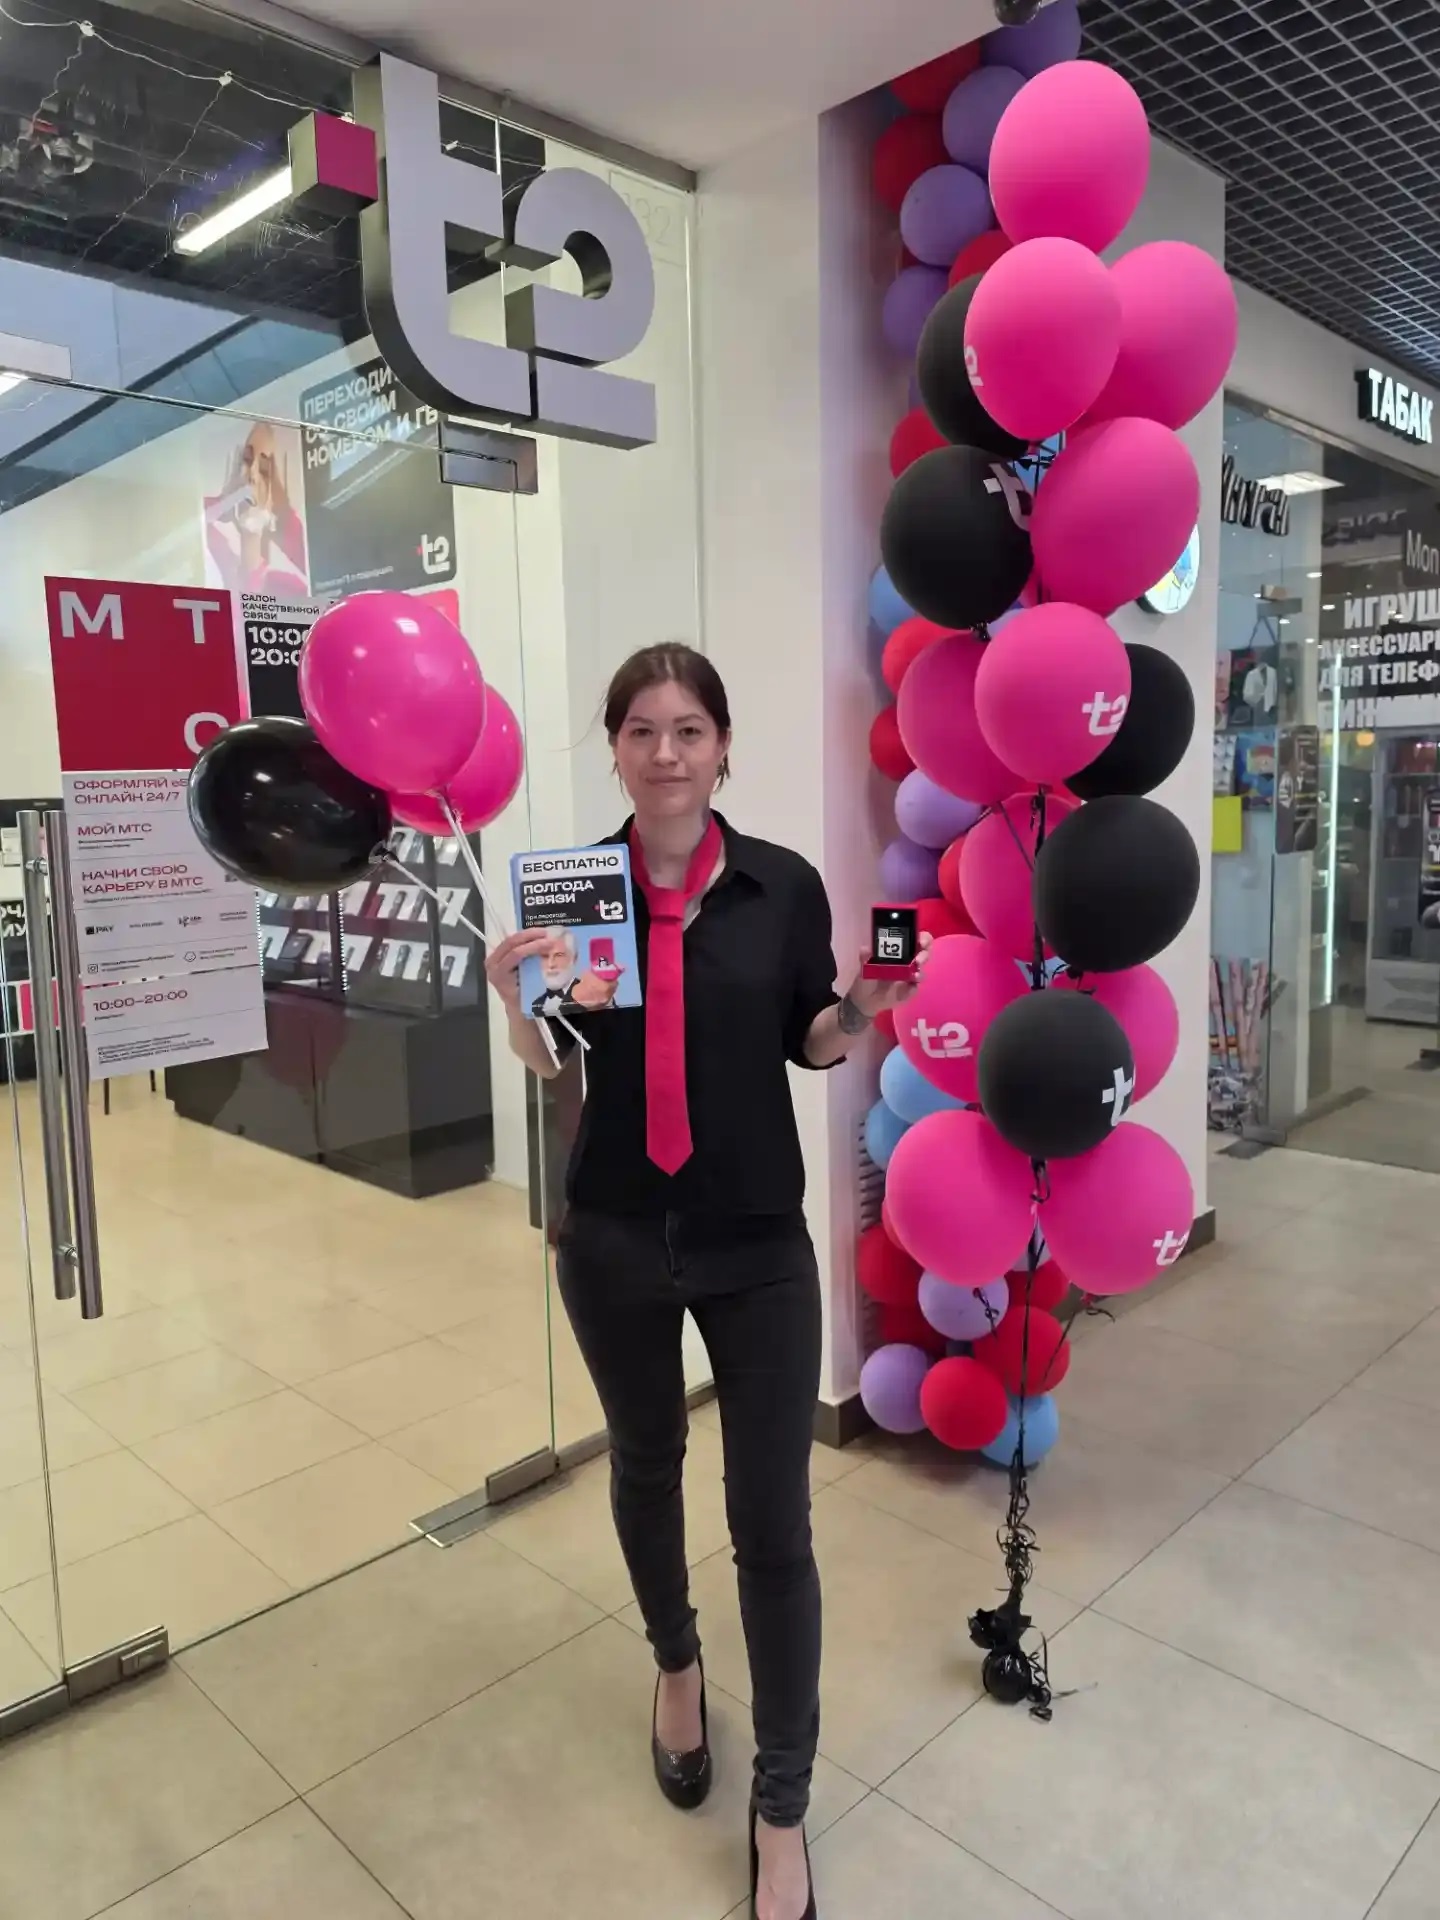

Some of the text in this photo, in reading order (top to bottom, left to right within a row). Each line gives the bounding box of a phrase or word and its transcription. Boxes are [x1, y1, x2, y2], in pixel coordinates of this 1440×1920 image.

[290, 52, 657, 446] t2
[304, 366, 398, 419] ПЕРЕХОДИ
[1368, 368, 1434, 444] ТАБАК
[983, 463, 1032, 532] t
[417, 534, 450, 575] t2
[241, 593, 277, 603] САЛОН
[242, 603, 320, 615] КАЧЕСТВЕННОЙ
[243, 611, 277, 620] СВЯЗИ
[250, 647, 301, 667] 20:0
[1368, 660, 1440, 687] ТЕЛЕФ
[1081, 691, 1128, 736] t2
[1317, 697, 1378, 729] БИЖ
[73, 776, 190, 791] ОФОРМЛЯЙ eS
[74, 791, 180, 804] ОНЛАЙН 24/7
[77, 822, 153, 837] МОЙ МТС
[81, 864, 188, 881] НАЧНИ СВОЮ
[522, 856, 619, 873] БЕСПЛАТНО
[83, 876, 204, 895] КАРЬЕРУ В МТС
[523, 880, 595, 896] ПОЛГОДА
[524, 893, 576, 907] СВЯЗИ
[594, 899, 625, 921] t2
[881, 941, 901, 957] t2
[911, 1018, 974, 1059] t2
[1101, 1066, 1133, 1127] t
